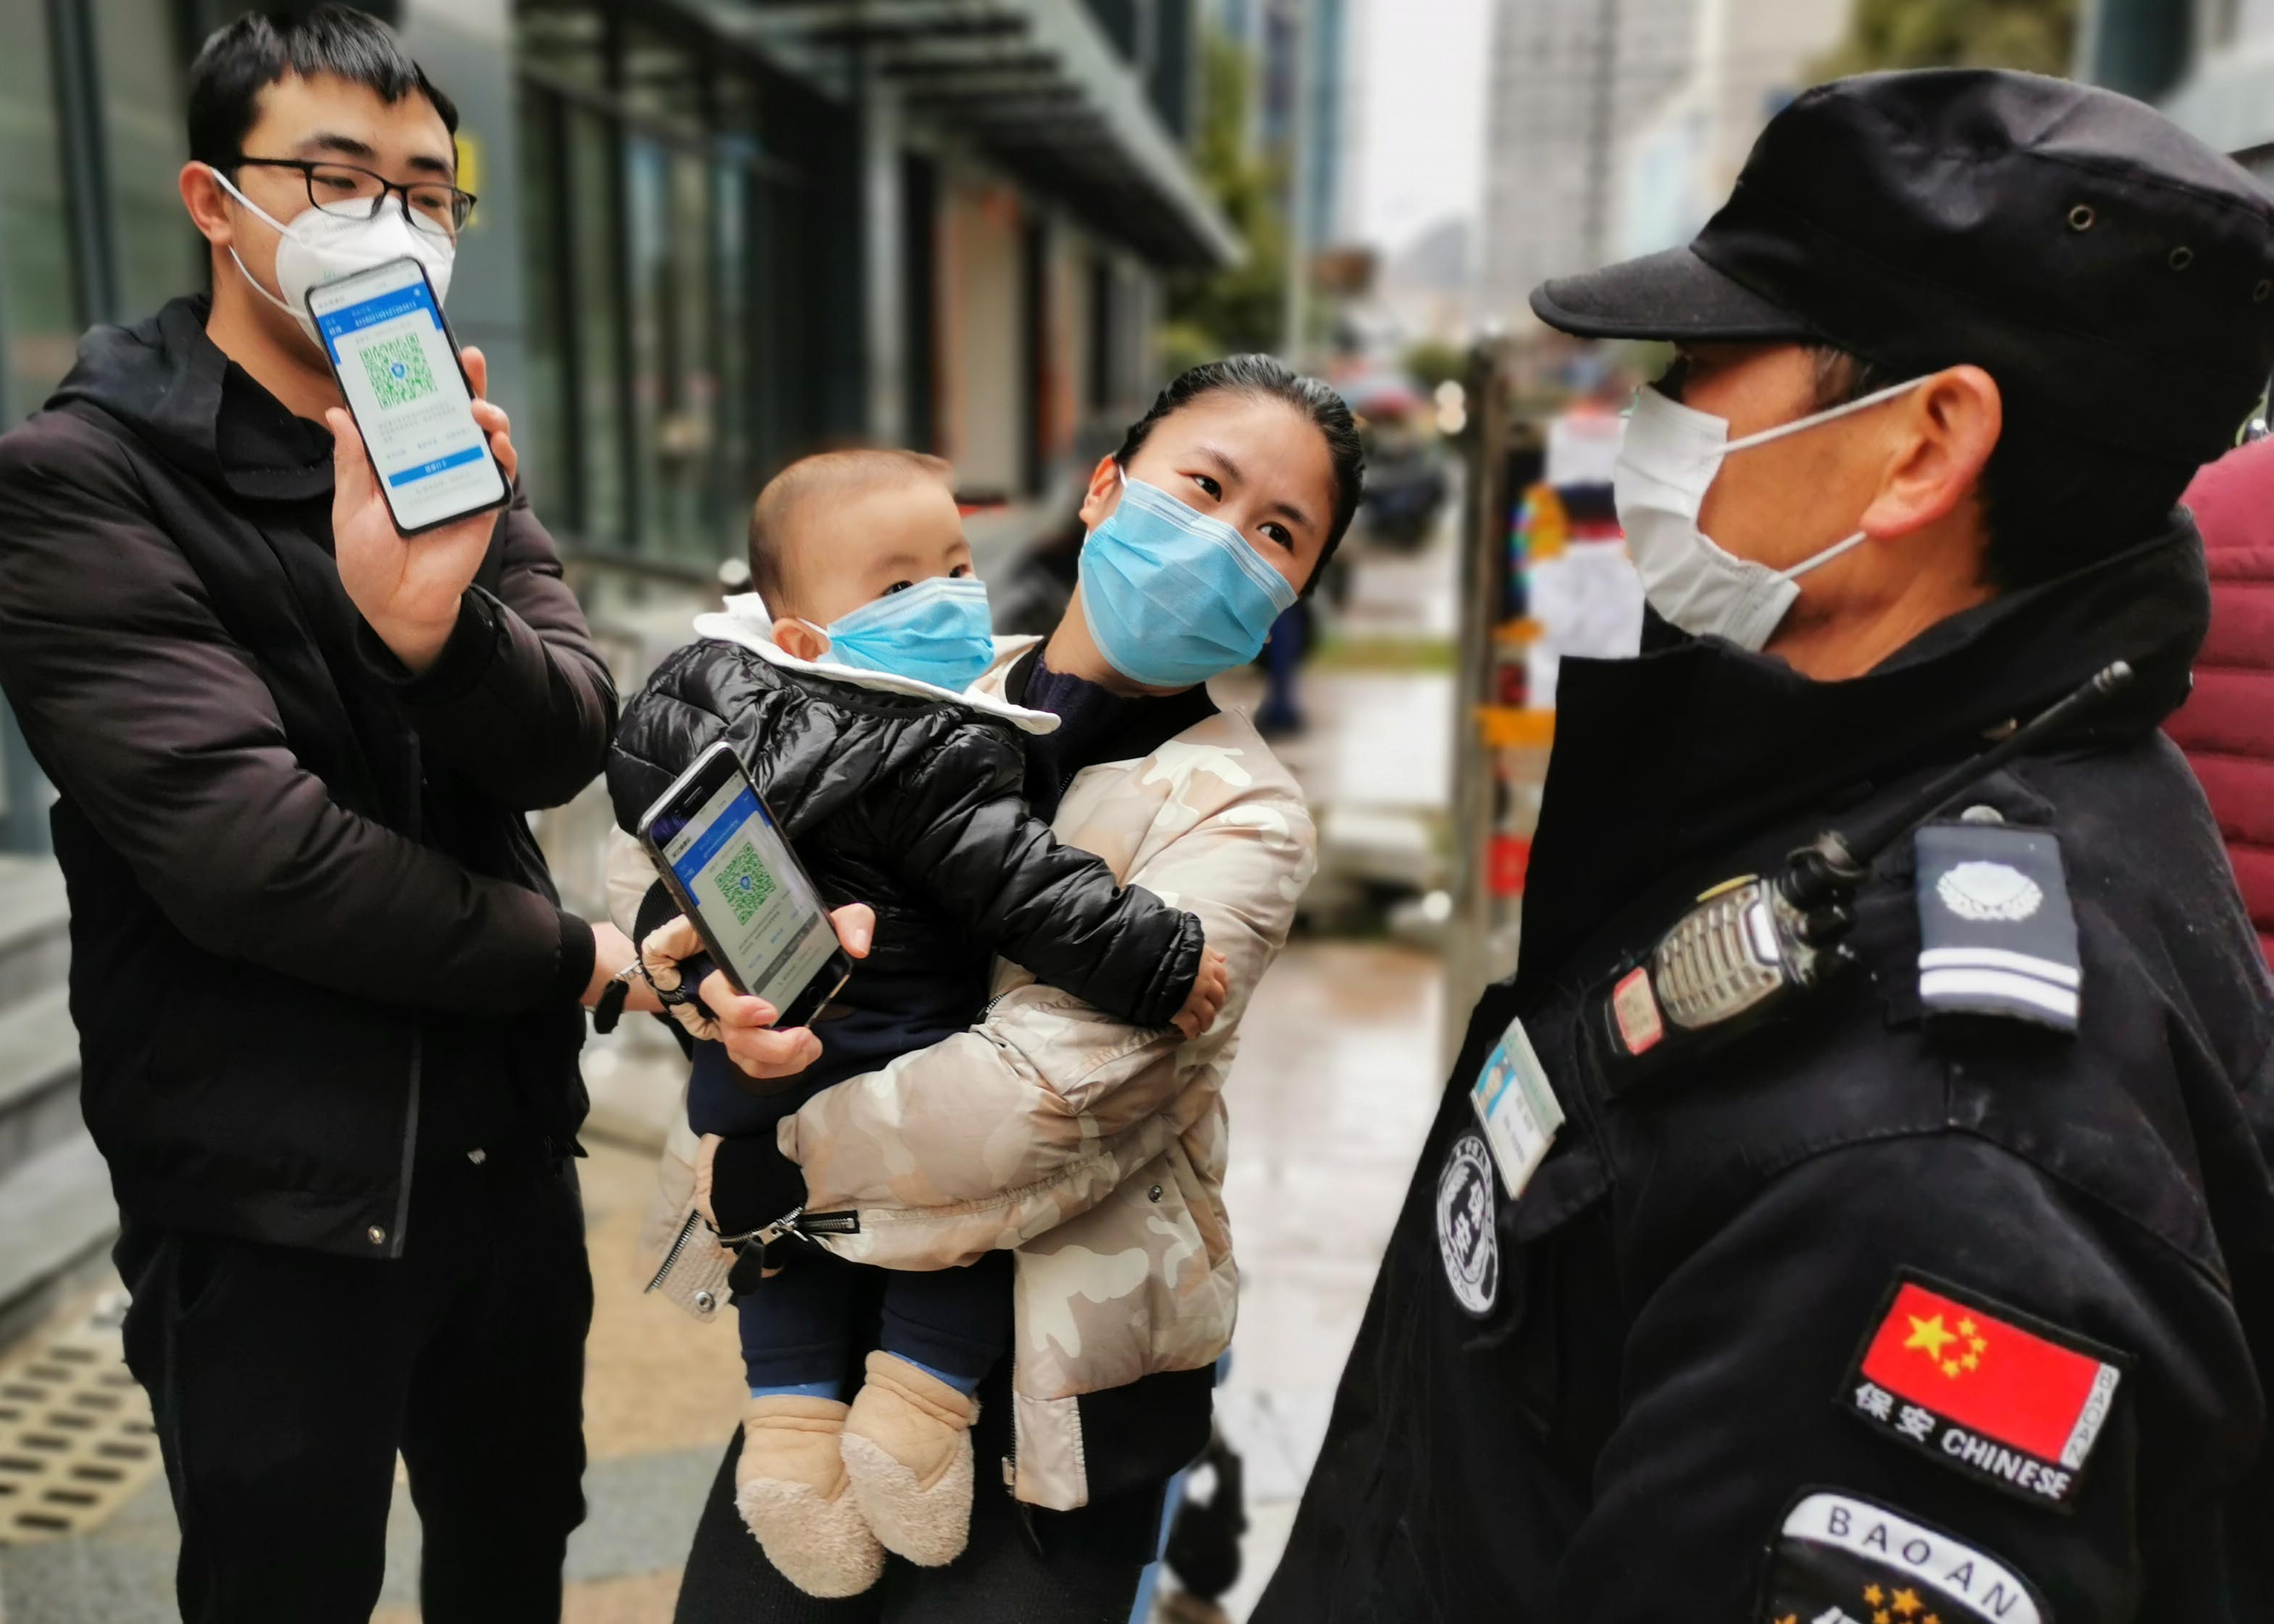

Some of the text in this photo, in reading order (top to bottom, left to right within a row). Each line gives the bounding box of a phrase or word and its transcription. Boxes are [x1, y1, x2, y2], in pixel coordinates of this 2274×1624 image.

[1855, 1382, 2070, 1500] 保安 CHINESE
[2068, 1368, 2113, 1462] BAOAN
